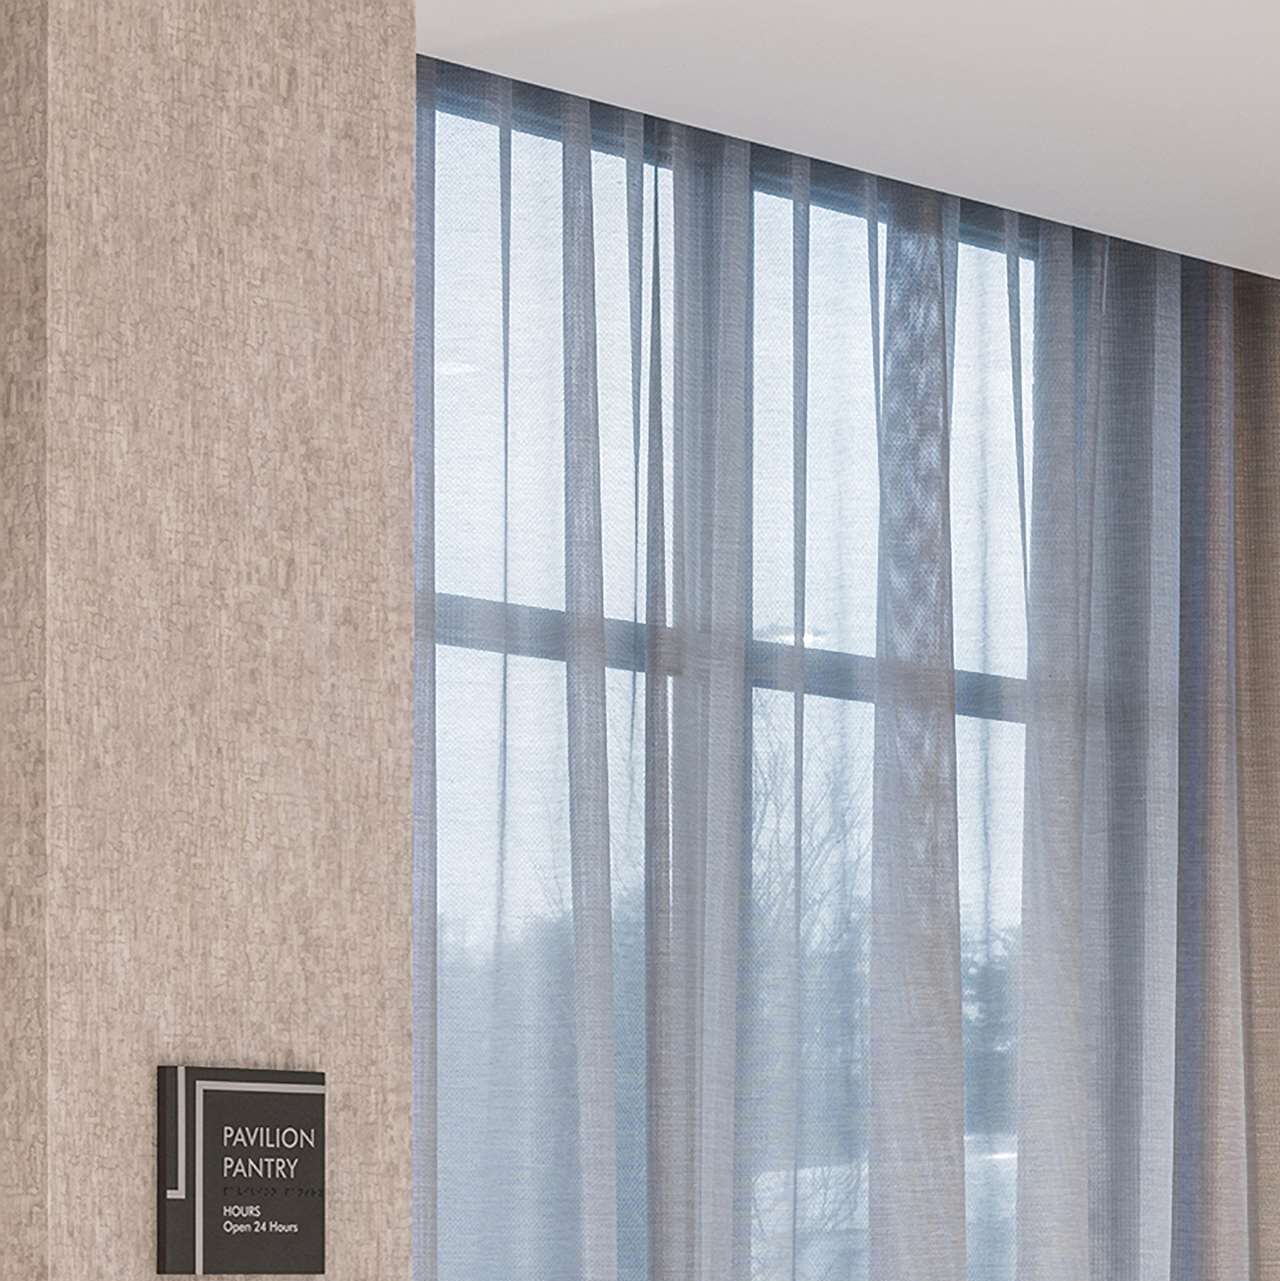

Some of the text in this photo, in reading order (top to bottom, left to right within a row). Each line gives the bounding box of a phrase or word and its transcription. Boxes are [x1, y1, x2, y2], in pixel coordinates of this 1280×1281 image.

[223, 1126, 315, 1148] PAVILION
[223, 1157, 299, 1178] PANTRY
[223, 1205, 261, 1217] HOURS
[223, 1221, 298, 1234] Open 24 Hours
